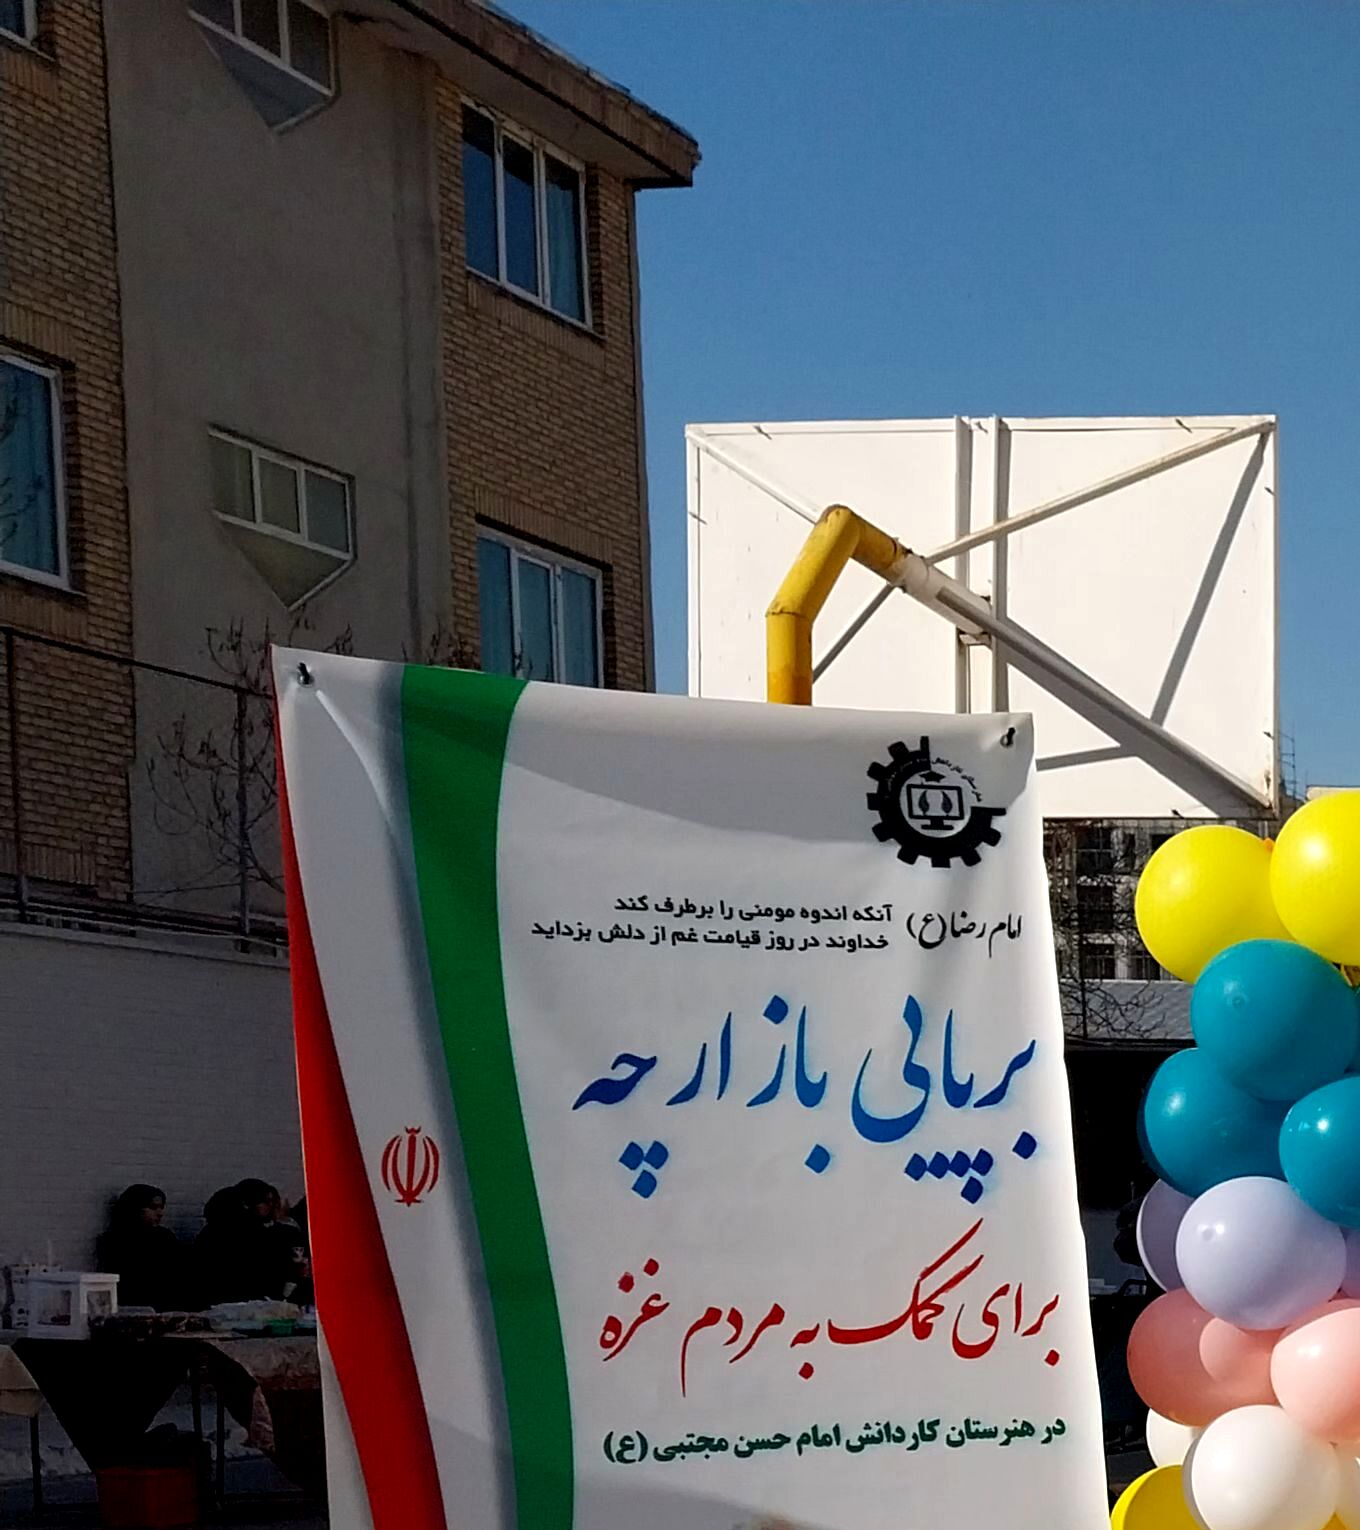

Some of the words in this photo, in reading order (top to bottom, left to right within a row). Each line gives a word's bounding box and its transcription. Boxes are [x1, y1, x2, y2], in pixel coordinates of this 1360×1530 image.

[614, 894, 649, 911] کند
[654, 896, 714, 919] برطرف
[719, 899, 734, 920] را
[738, 904, 795, 923] مومنی
[800, 905, 848, 924] اندوه
[852, 904, 893, 922] آنکه
[531, 919, 592, 942] بزداید
[598, 923, 646, 943] دلش
[649, 925, 667, 946] از
[671, 927, 699, 946] غم
[950, 910, 986, 939] رضا
[988, 912, 1022, 959] امام
[703, 929, 762, 949] قیامت
[764, 930, 795, 951] روز
[798, 936, 820, 952] در
[825, 932, 889, 953] خداوند
[571, 994, 831, 1199] بازارچه
[850, 994, 1038, 1204] برپایی
[827, 1217, 984, 1344] کمک
[598, 1257, 671, 1362] غزه
[951, 1281, 1060, 1367] برای
[680, 1302, 786, 1398] مردم
[789, 1317, 821, 1381] به
[796, 1422, 841, 1457] امام
[945, 1415, 1036, 1448] هنرستان
[1040, 1416, 1067, 1445] در
[602, 1429, 649, 1465] (ع)
[652, 1432, 729, 1462] مجتبی
[733, 1431, 792, 1459] حسن
